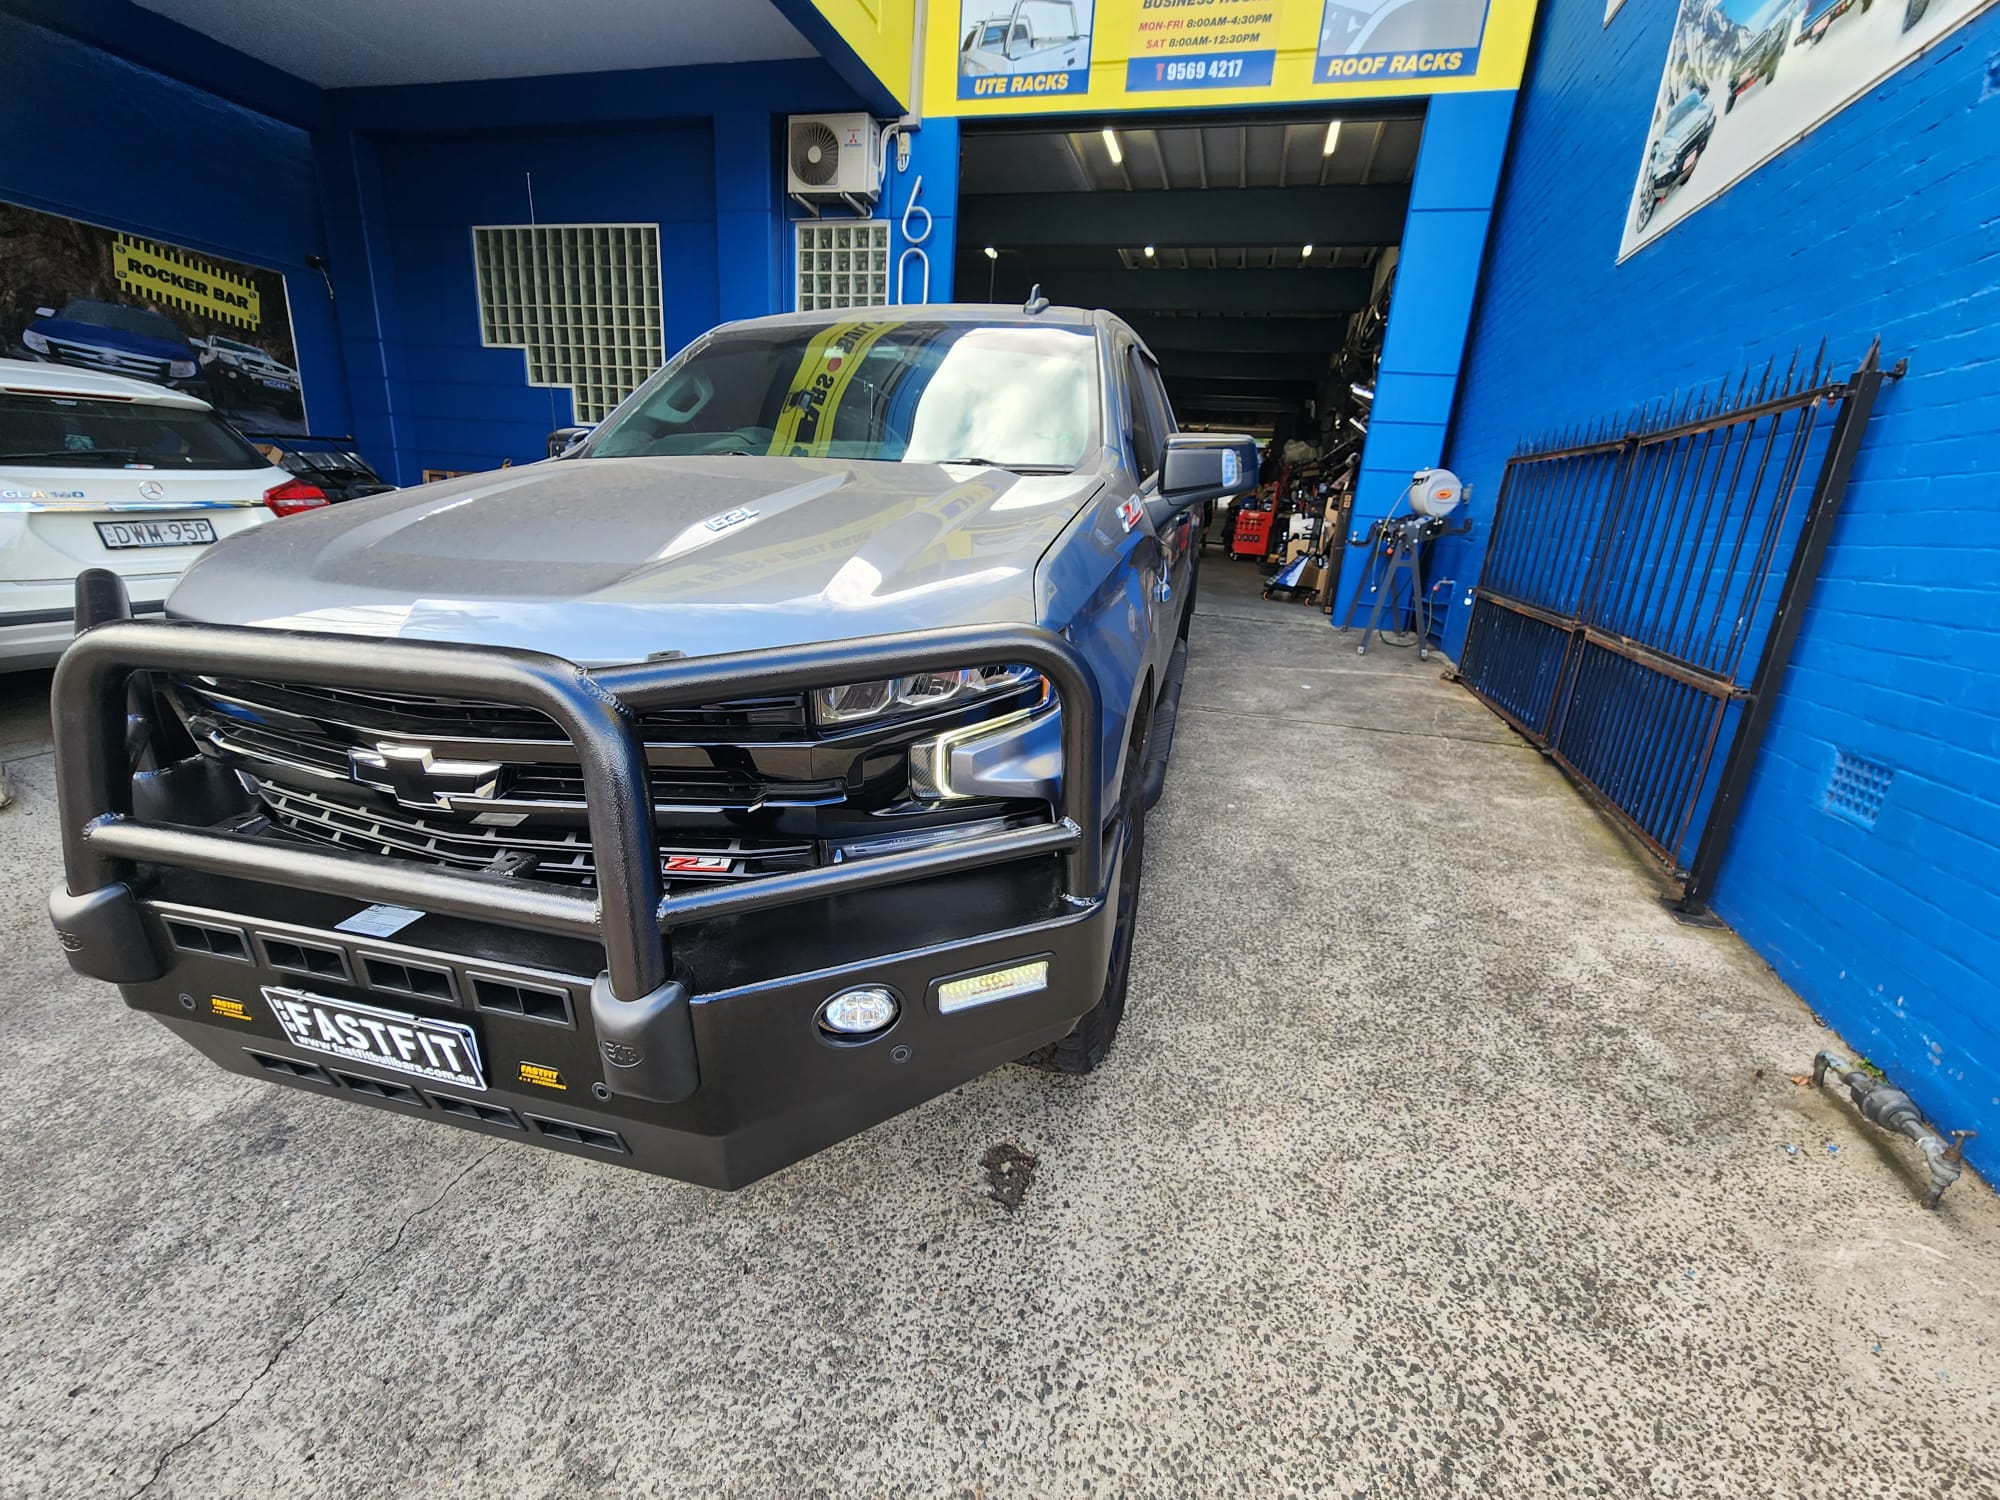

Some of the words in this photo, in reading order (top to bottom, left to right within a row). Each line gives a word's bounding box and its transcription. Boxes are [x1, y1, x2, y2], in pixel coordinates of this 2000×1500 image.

[1138, 19, 1185, 32] MON-FRI
[1186, 13, 1273, 29] 8:00AM-4:30PM
[1146, 38, 1167, 49] SAT
[1168, 32, 1261, 48] 8:00AM-12:30PM
[1166, 61, 1206, 81] 9569
[1207, 59, 1244, 79] 4217
[1326, 55, 1388, 77] ROOF
[1388, 51, 1464, 73] RACKS
[974, 76, 1009, 95] UTE
[1010, 72, 1070, 93] RACKS
[127, 257, 209, 297] ROCKER
[212, 286, 249, 310] BAR
[2, 489, 47, 499] GLA
[283, 1000, 462, 1073] FASTFIT
